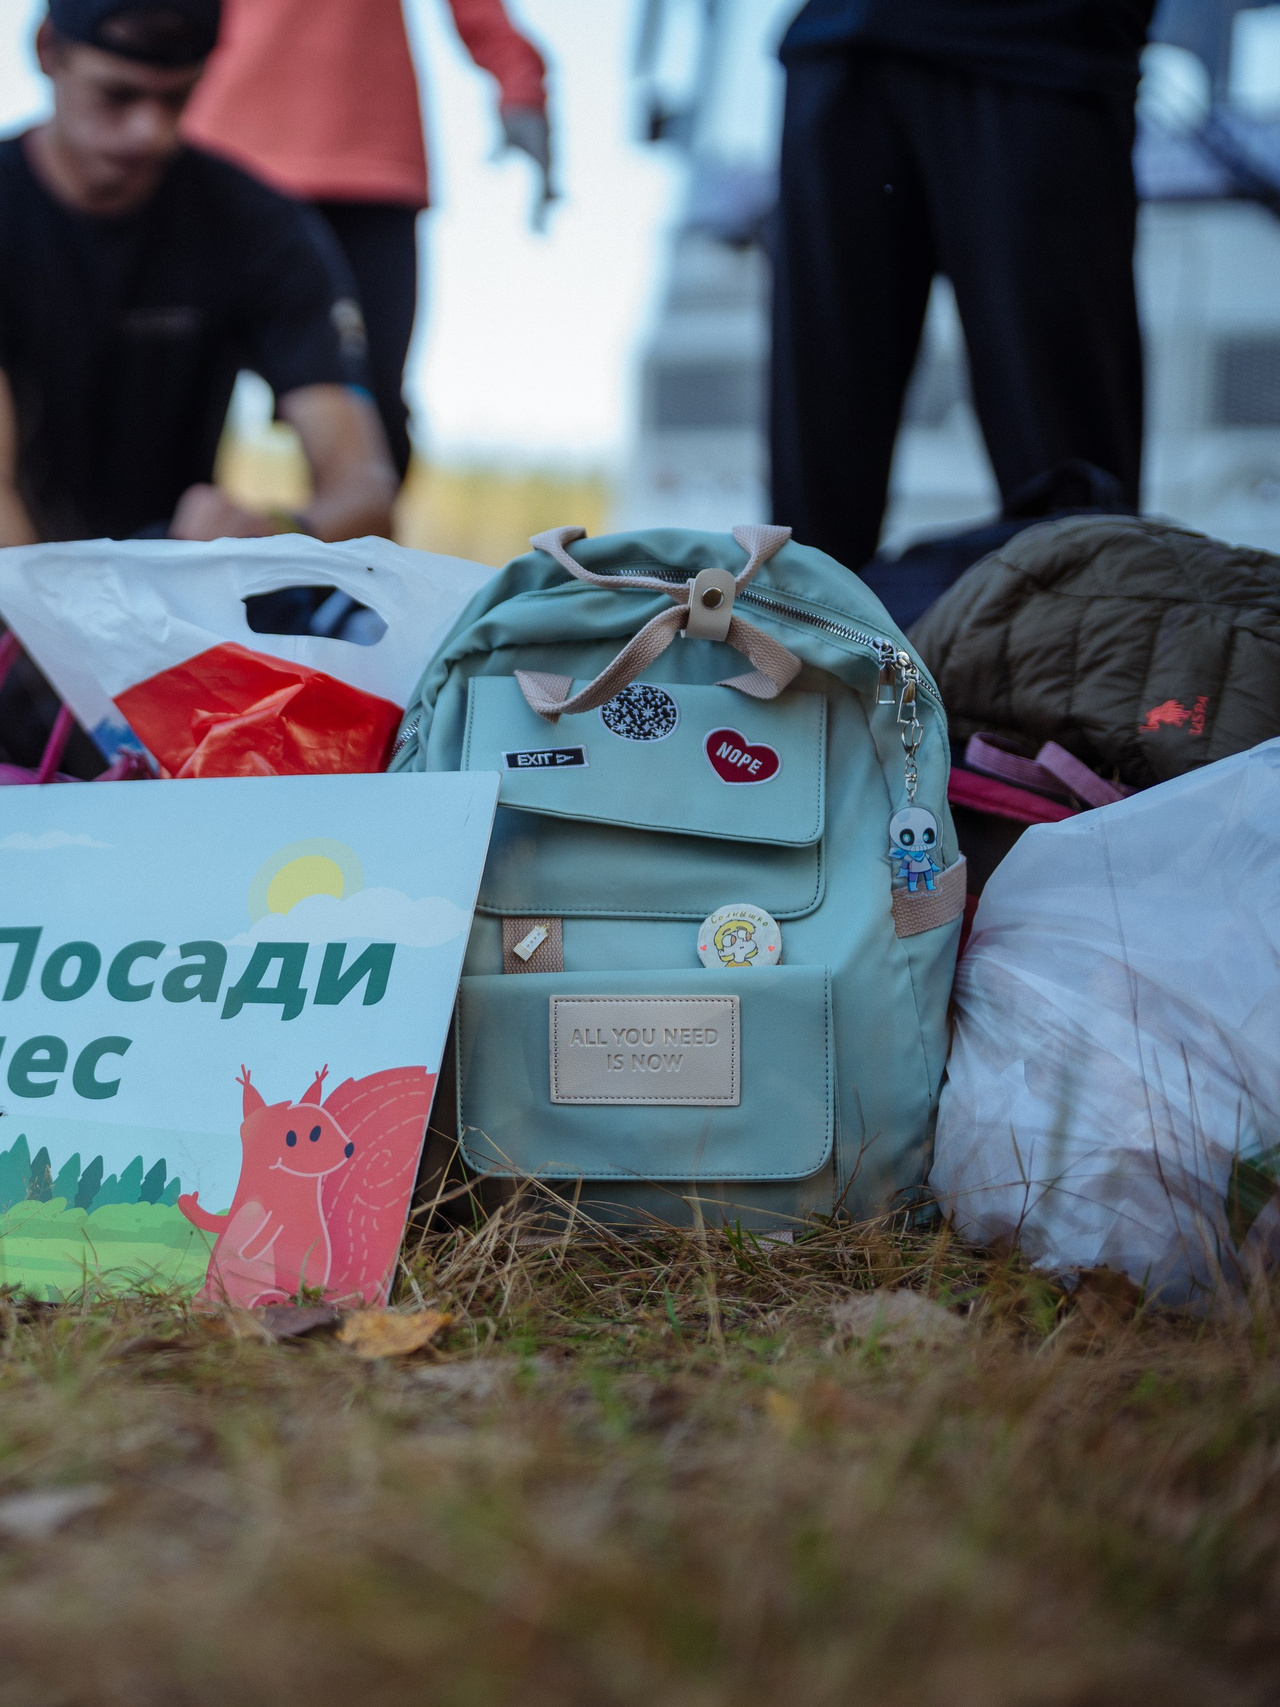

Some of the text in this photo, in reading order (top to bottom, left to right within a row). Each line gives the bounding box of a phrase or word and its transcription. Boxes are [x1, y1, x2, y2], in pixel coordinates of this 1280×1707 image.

[1188, 695, 1209, 736] USPA
[517, 752, 553, 766] EXIT
[715, 741, 763, 775] NOPE
[570, 1028, 719, 1047] ALL YOU NEED
[606, 1053, 683, 1072] IS NOW
